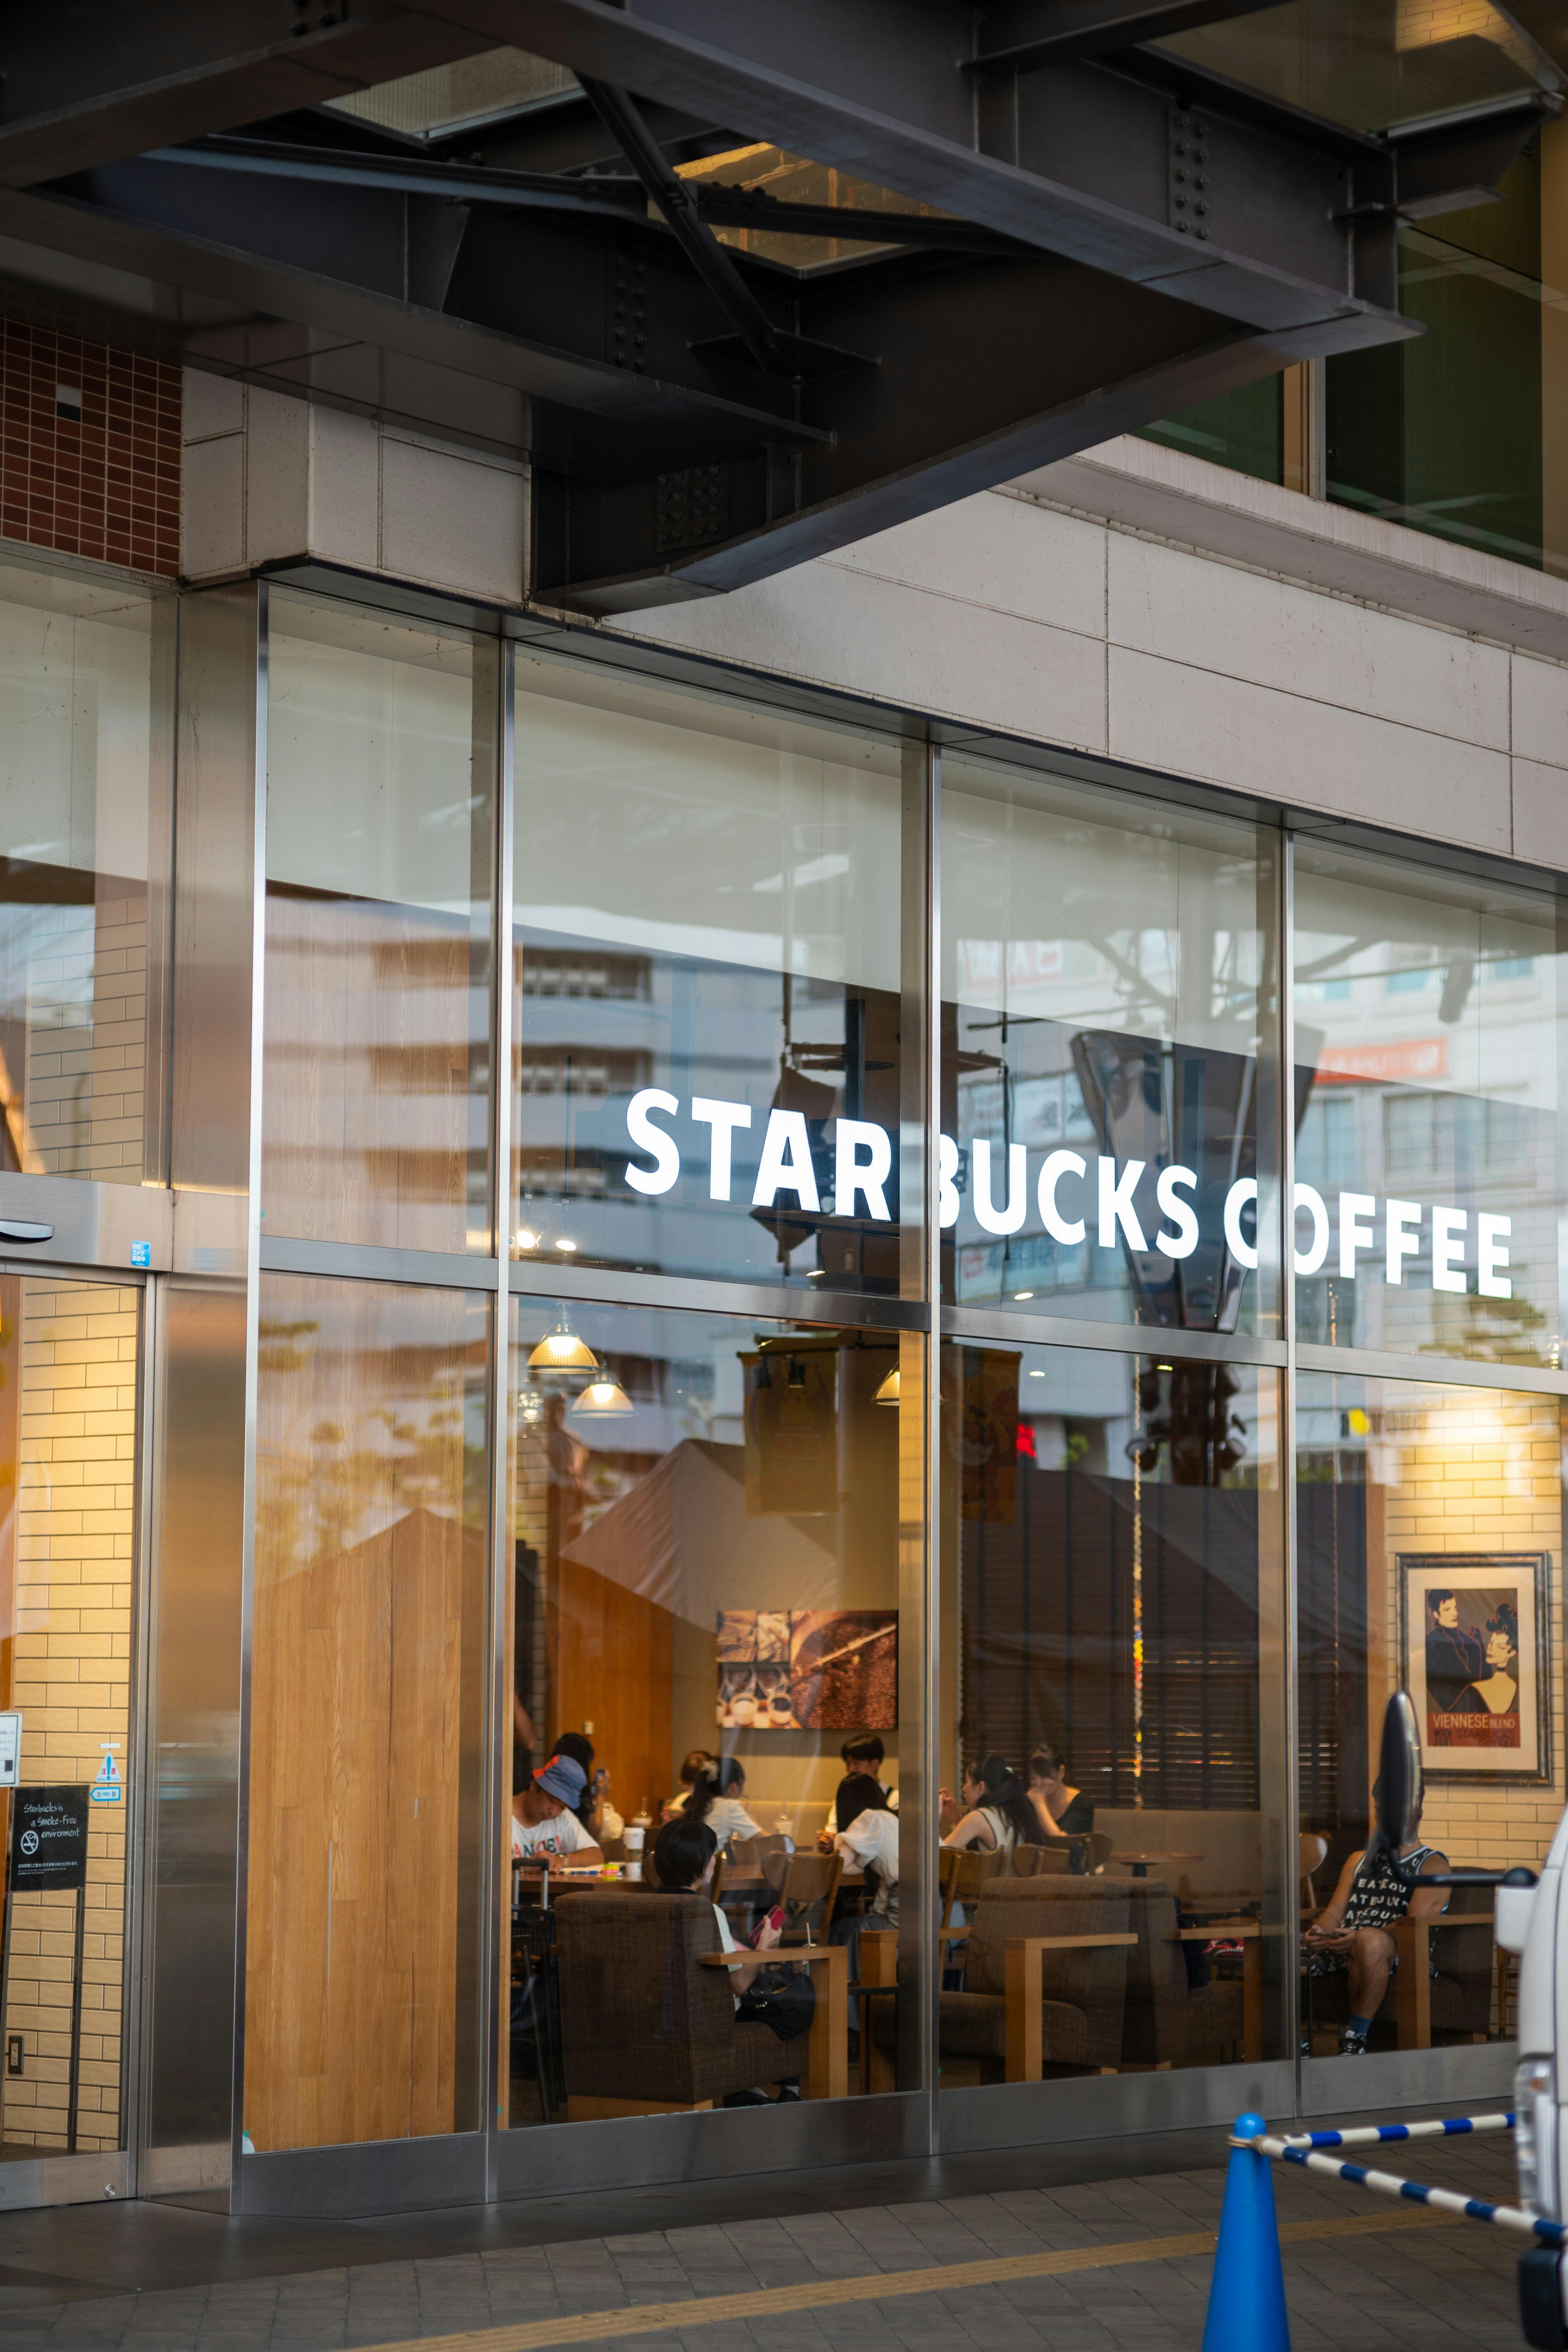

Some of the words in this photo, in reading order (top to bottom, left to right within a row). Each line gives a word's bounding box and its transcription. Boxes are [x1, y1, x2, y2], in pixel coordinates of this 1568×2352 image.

[1224, 1177, 1512, 1299] COFFEE
[1432, 1714, 1489, 1728] VIENNESE
[1489, 1718, 1515, 1729] BLEND
[1456, 1729, 1515, 1740] STARBUCKS
[24, 1802, 57, 1813] Starbucks
[58, 1803, 63, 1812] is
